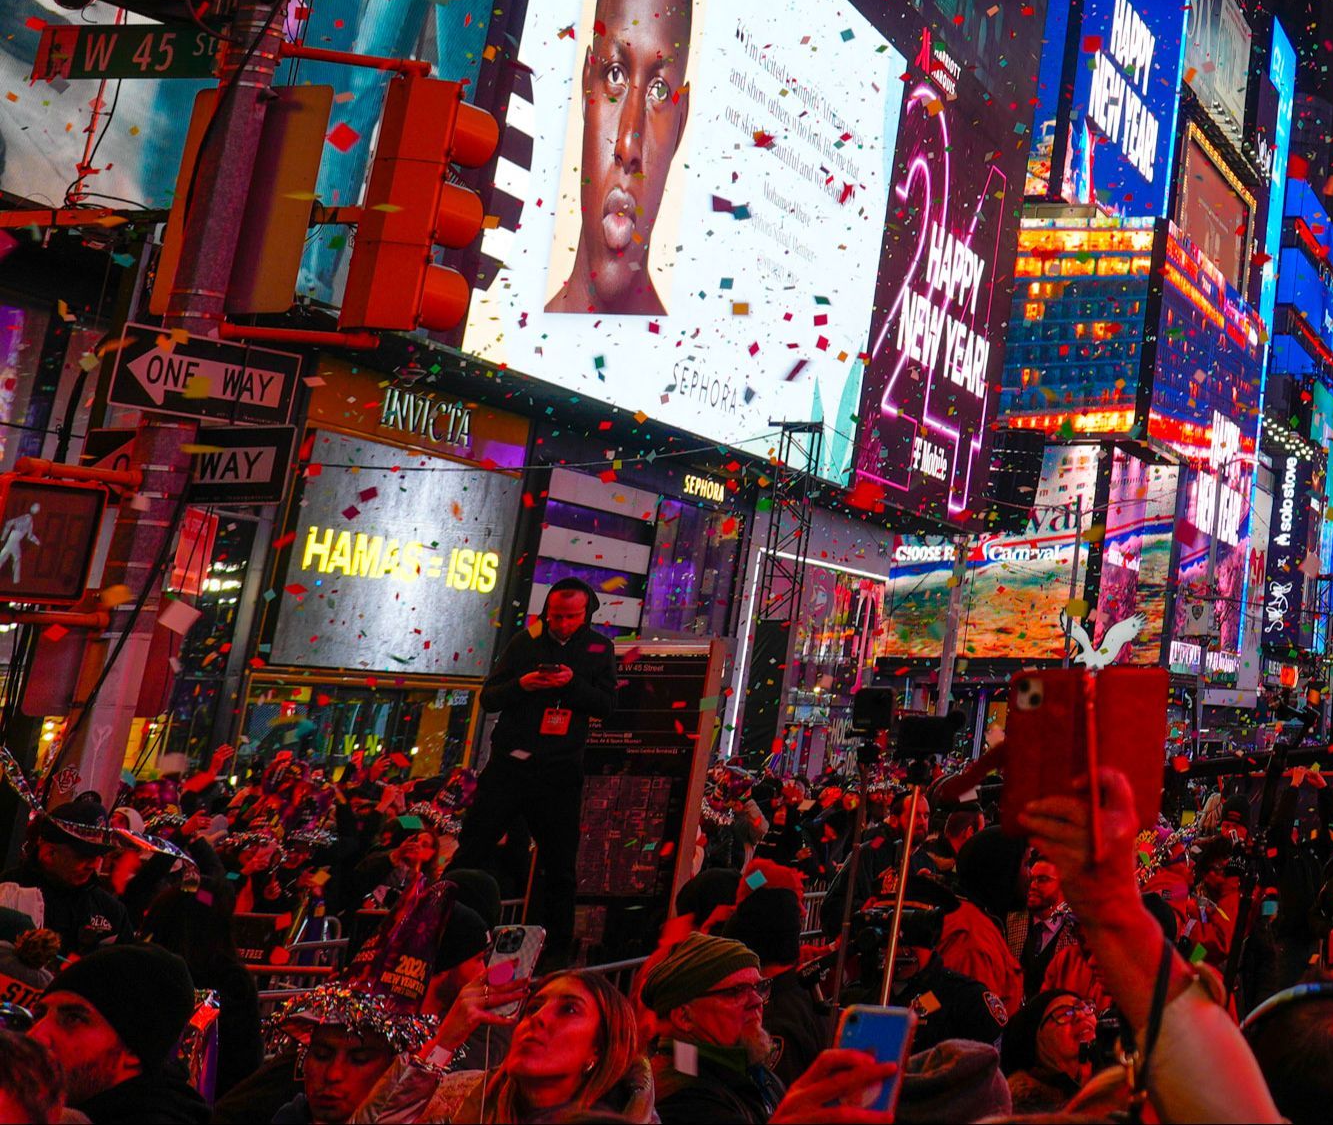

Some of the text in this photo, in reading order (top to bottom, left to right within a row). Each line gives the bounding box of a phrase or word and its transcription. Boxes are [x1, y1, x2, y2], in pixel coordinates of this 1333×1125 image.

[82, 32, 120, 73] W
[132, 30, 176, 72] 45
[1088, 49, 1124, 144] NEW
[925, 221, 986, 316] HAPPY
[897, 286, 943, 370] NEW
[146, 354, 275, 403] ONE WAY
[671, 361, 738, 415] SEPHORA
[378, 385, 472, 450] INVICTA
[200, 451, 264, 481] WAY
[683, 473, 726, 503] SEPHORA
[302, 525, 423, 584] HAMAS
[446, 546, 500, 595] ISIS
